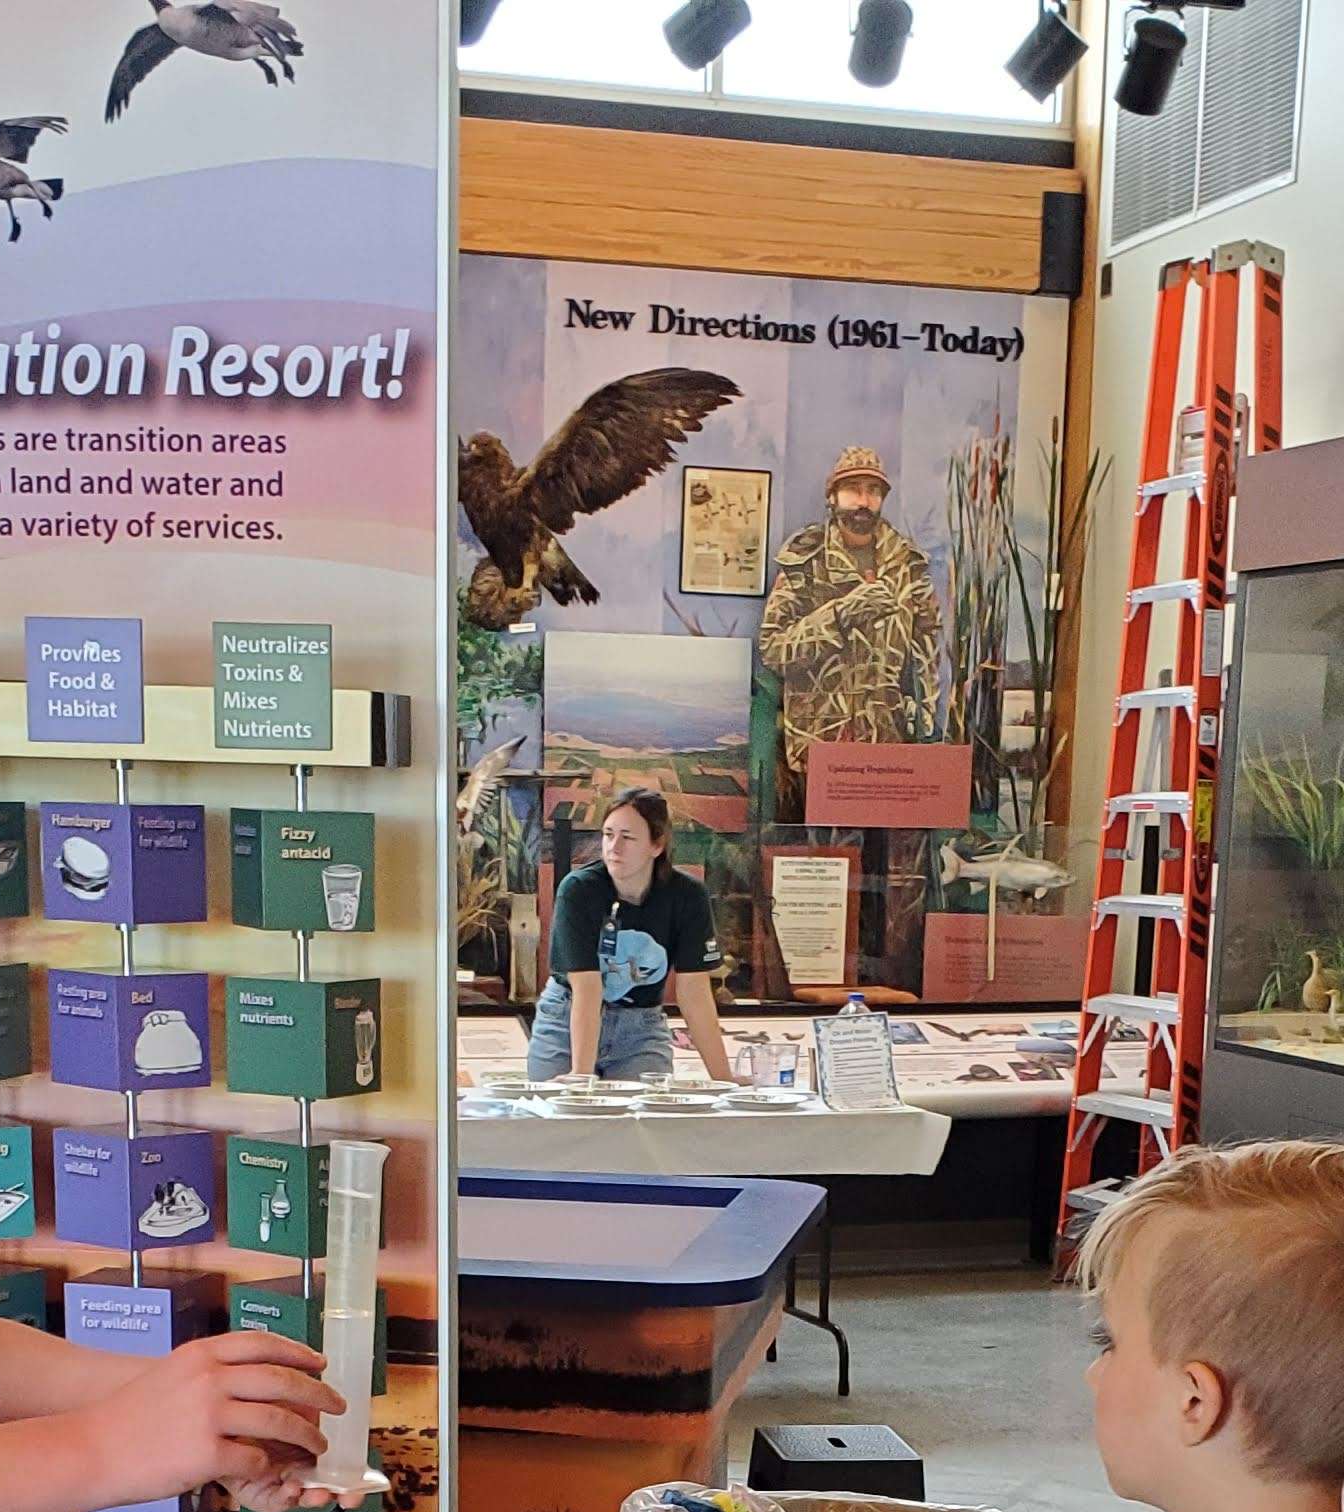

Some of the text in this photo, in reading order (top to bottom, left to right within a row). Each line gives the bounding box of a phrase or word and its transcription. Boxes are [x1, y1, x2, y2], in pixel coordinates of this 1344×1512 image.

[564, 299, 636, 332] New
[648, 304, 816, 345] Directions
[164, 325, 410, 400] Resort!
[14, 433, 58, 454] are
[64, 426, 203, 455] transition
[211, 434, 287, 456] areas
[9, 467, 71, 496] land
[80, 467, 133, 497] and
[141, 473, 222, 498] water
[229, 468, 284, 498] and
[21, 509, 117, 544] variety
[126, 510, 155, 539] of
[162, 512, 284, 541] services.
[41, 643, 121, 664] Provides
[222, 635, 329, 655] Neutralizes
[49, 672, 115, 690] Food &
[222, 664, 304, 682] Toxins &
[48, 700, 118, 718] Habitat
[223, 692, 279, 710] Mixes
[223, 720, 313, 739] Nutrients
[52, 814, 111, 831] Hamburger
[281, 827, 316, 843] Fizzy
[281, 847, 331, 859] antacid
[131, 991, 153, 1004] Bed
[239, 992, 273, 1006] Mixes
[239, 1012, 294, 1026] nutrients
[64, 1143, 112, 1160] Shelter for
[140, 1151, 162, 1163] Zoo
[239, 1152, 288, 1173] Chemistry
[81, 1300, 162, 1315] Feeding area
[240, 1300, 281, 1318] Converts
[82, 1316, 149, 1331] for wildlife
